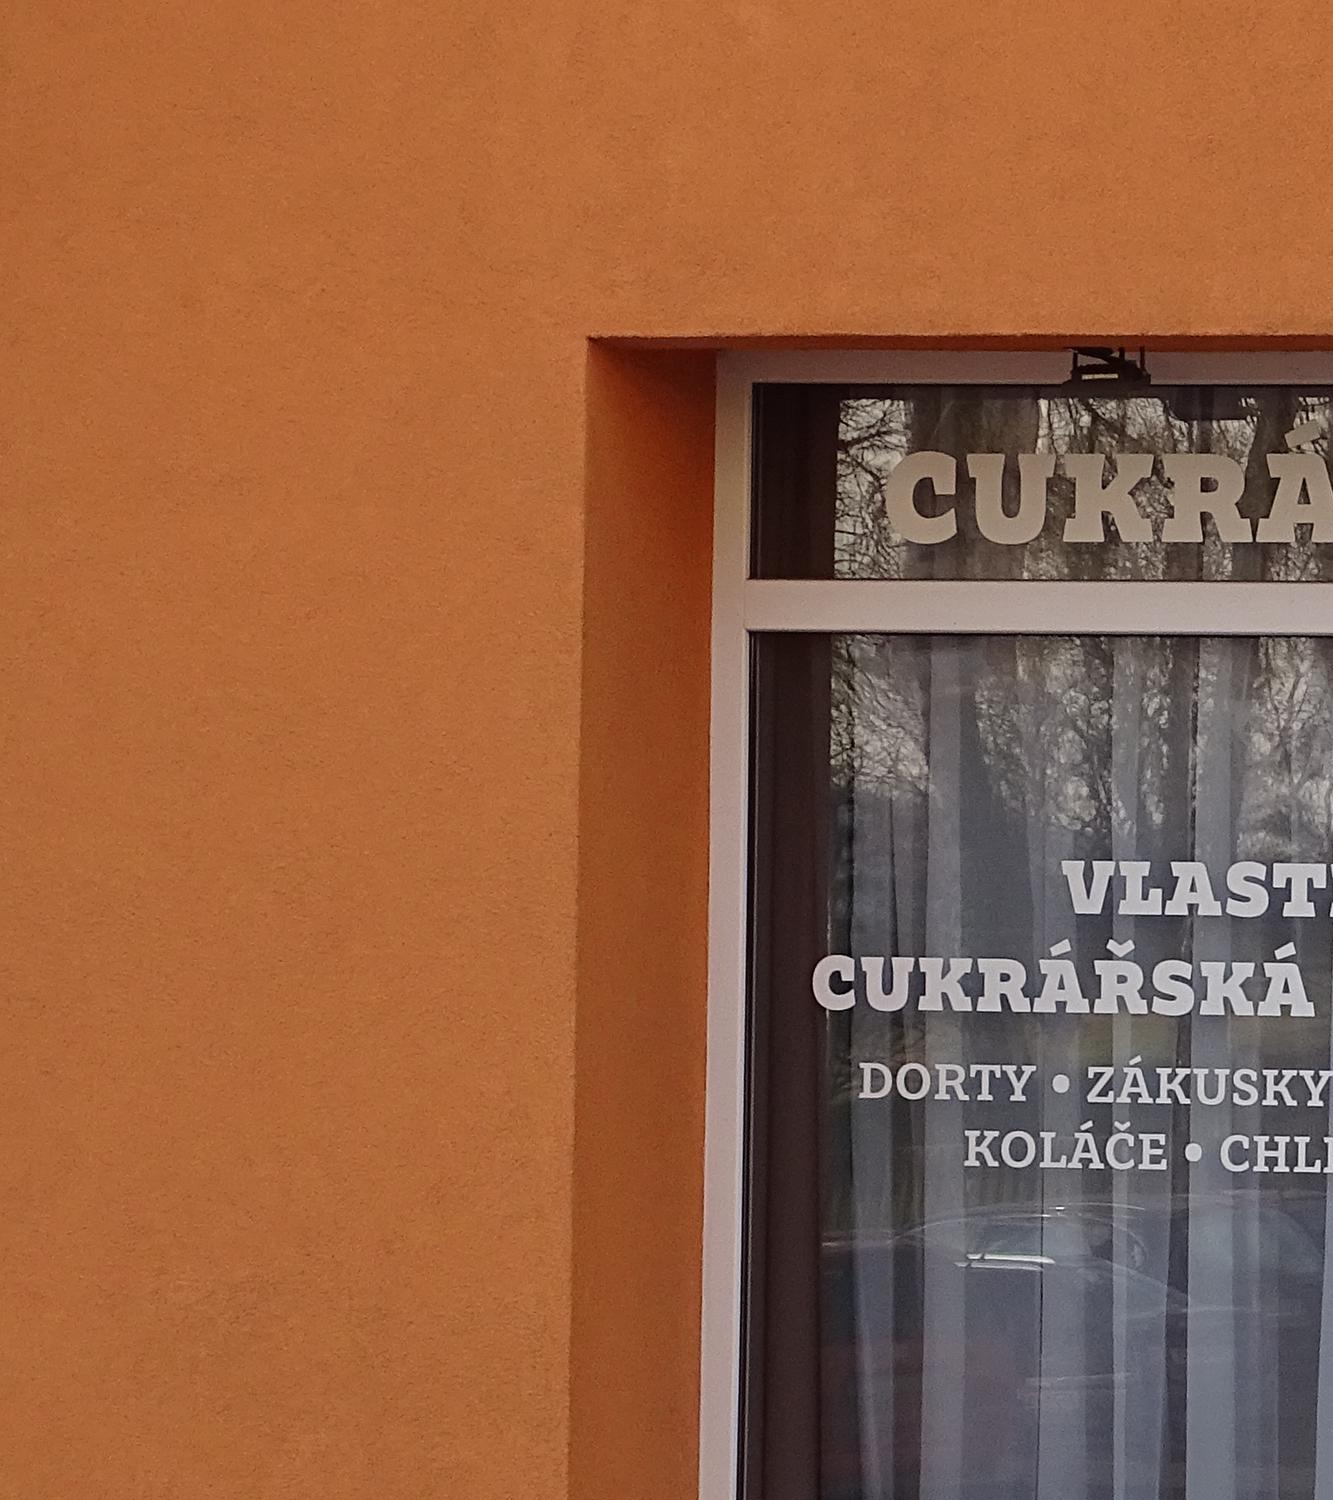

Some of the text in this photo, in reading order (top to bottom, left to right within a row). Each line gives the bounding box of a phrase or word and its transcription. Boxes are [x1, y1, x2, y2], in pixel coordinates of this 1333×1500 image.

[812, 939, 1316, 1018] CUKRÁŘSKÁ
[858, 1062, 1038, 1102] DORTY
[1087, 1055, 1333, 1107] ZÁKUSKY
[963, 1120, 1168, 1171] KOLÁČE
